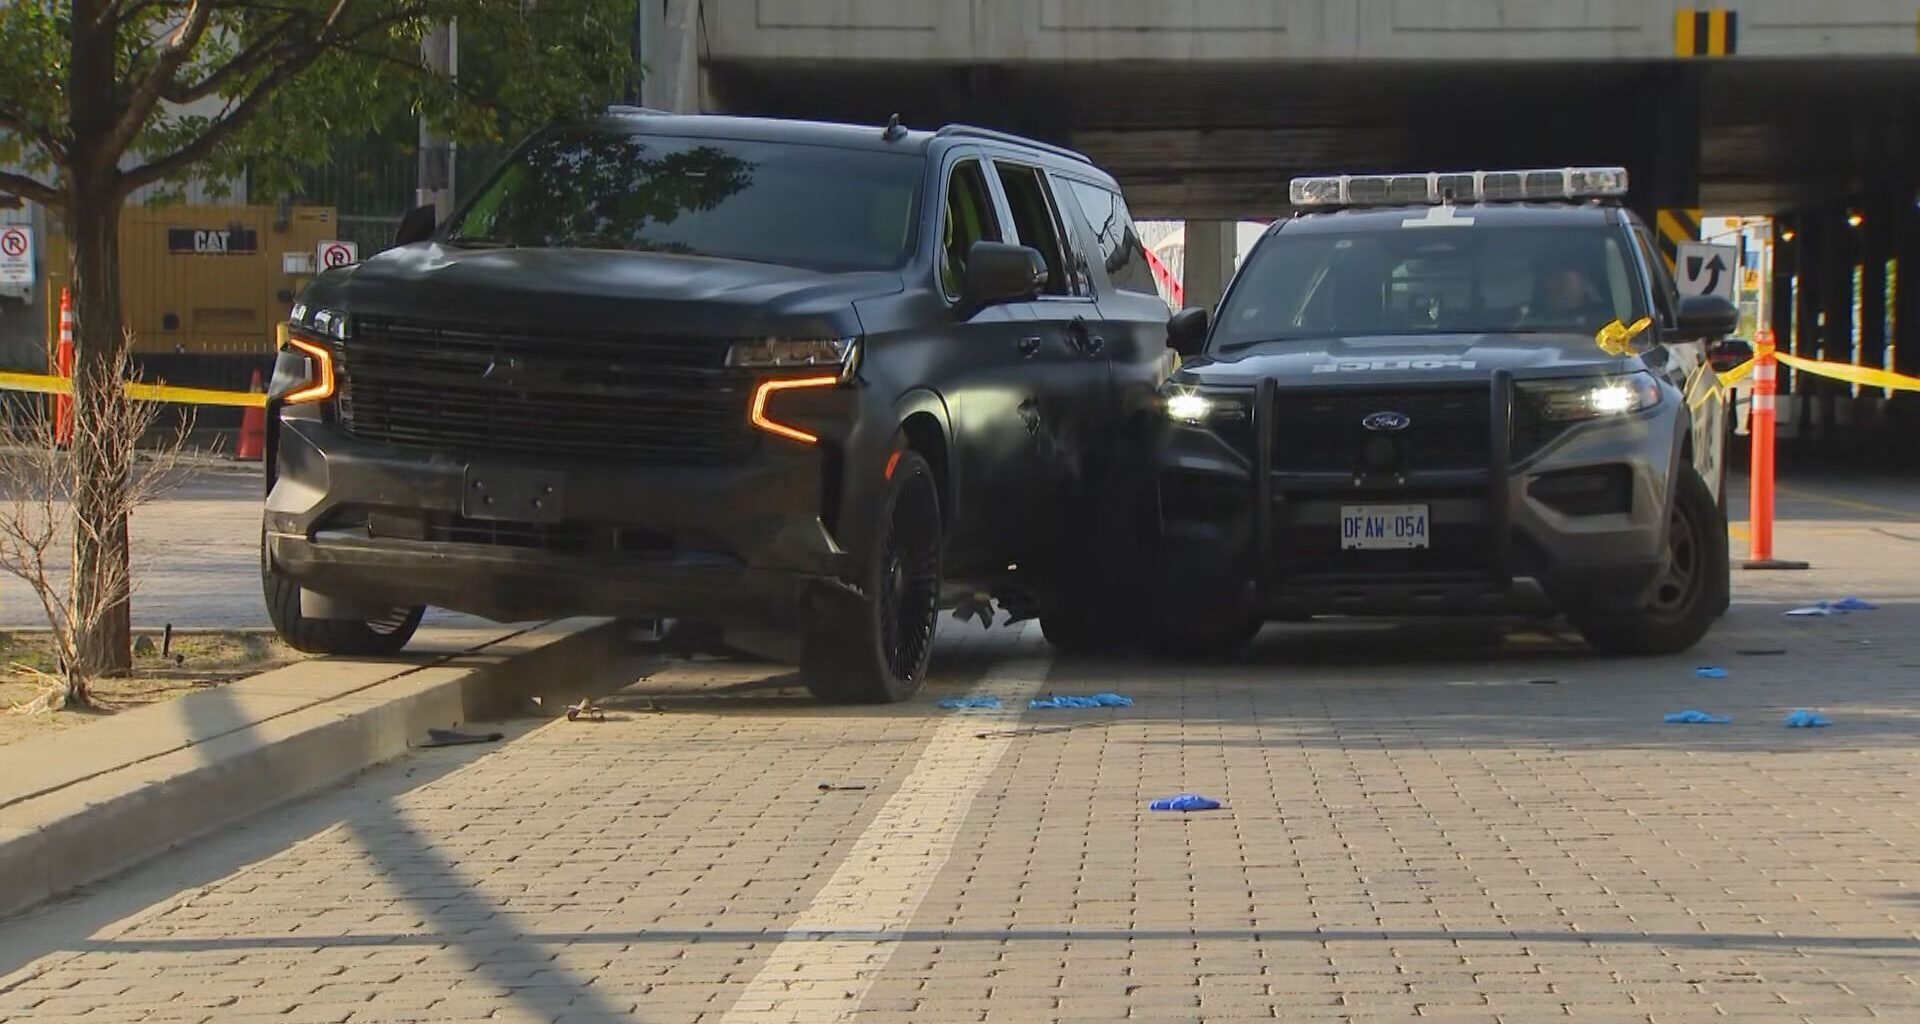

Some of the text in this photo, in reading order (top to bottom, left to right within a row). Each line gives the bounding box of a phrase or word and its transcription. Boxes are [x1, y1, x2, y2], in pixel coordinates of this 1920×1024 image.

[194, 230, 231, 252] CAT
[1344, 515, 1425, 538] DFAW 054
